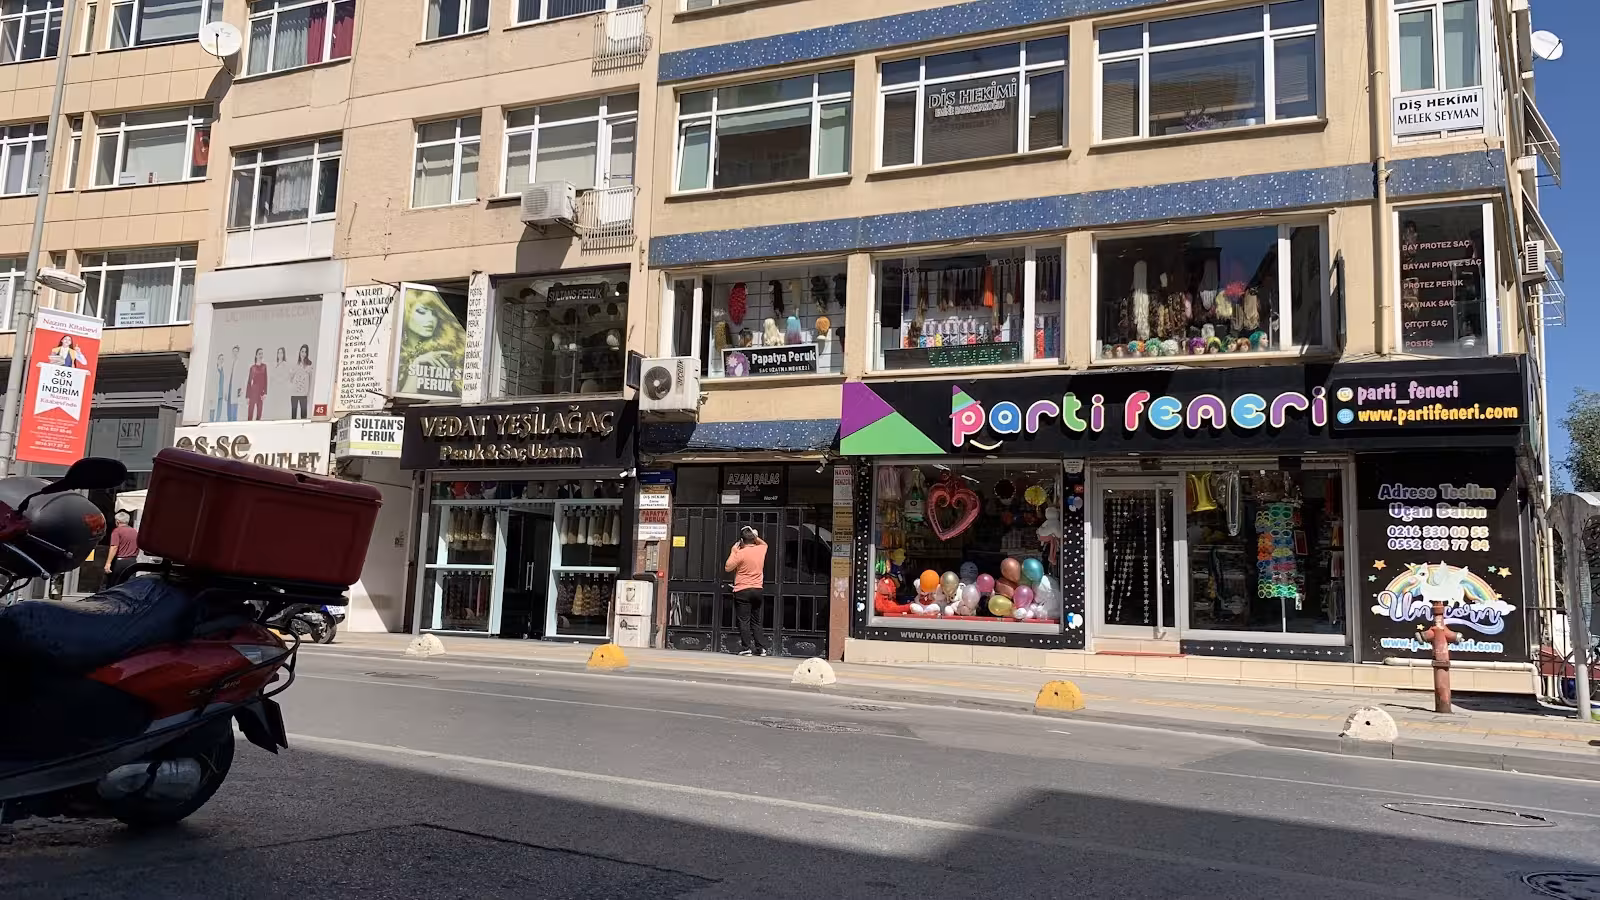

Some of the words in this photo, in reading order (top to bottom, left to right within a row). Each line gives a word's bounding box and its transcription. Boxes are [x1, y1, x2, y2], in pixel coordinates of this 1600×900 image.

[960, 78, 1016, 104] HEKİMİ
[1400, 100, 1422, 111] DİŞ
[1426, 92, 1478, 107] HEKİMİ
[1398, 112, 1431, 124] MELEK
[1434, 108, 1478, 122] SEYMAN
[1453, 240, 1470, 248] SAÇ
[1402, 262, 1430, 270] BAYAN
[1432, 260, 1463, 268] PROTEZ
[1403, 281, 1435, 289] PROTEZ
[1436, 280, 1464, 288] PERUK
[1404, 301, 1437, 309] KAYNAK
[1438, 300, 1456, 308] SAÇ
[1431, 320, 1448, 328] SAÇ
[752, 353, 787, 366] Papatya
[788, 350, 816, 362] Peruk
[54, 369, 72, 378] 365
[408, 364, 462, 380] SULTAN'S
[52, 377, 72, 387] GÜN
[416, 377, 453, 392] PERUK
[42, 383, 79, 396] İNDİRİM
[1357, 380, 1459, 405] parti_feneri
[316, 406, 324, 414] 45
[950, 390, 1105, 448] parti
[1125, 386, 1326, 431] feneri
[1358, 403, 1518, 425] www.partifeneri.com
[354, 418, 404, 430] SULTAN'S
[420, 415, 490, 437] VEDAT
[496, 405, 614, 439] YEŞİLAĞAÇ
[121, 422, 141, 437] SER
[361, 430, 395, 442] PERUK
[727, 474, 752, 485] AZAM
[1378, 484, 1437, 500] Adrese
[1439, 484, 1496, 500] Teslim
[1389, 502, 1432, 522] Uçan
[1436, 503, 1487, 519] Balon
[1387, 526, 1421, 538] 0216
[1422, 526, 1449, 538] 330
[1450, 526, 1469, 538] 00
[1470, 526, 1489, 538] 55
[1388, 538, 1421, 550] 0552
[1423, 538, 1449, 551] 884
[1451, 539, 1468, 551] 77
[1471, 539, 1490, 551] 84
[1377, 590, 1505, 635] Uncorn
